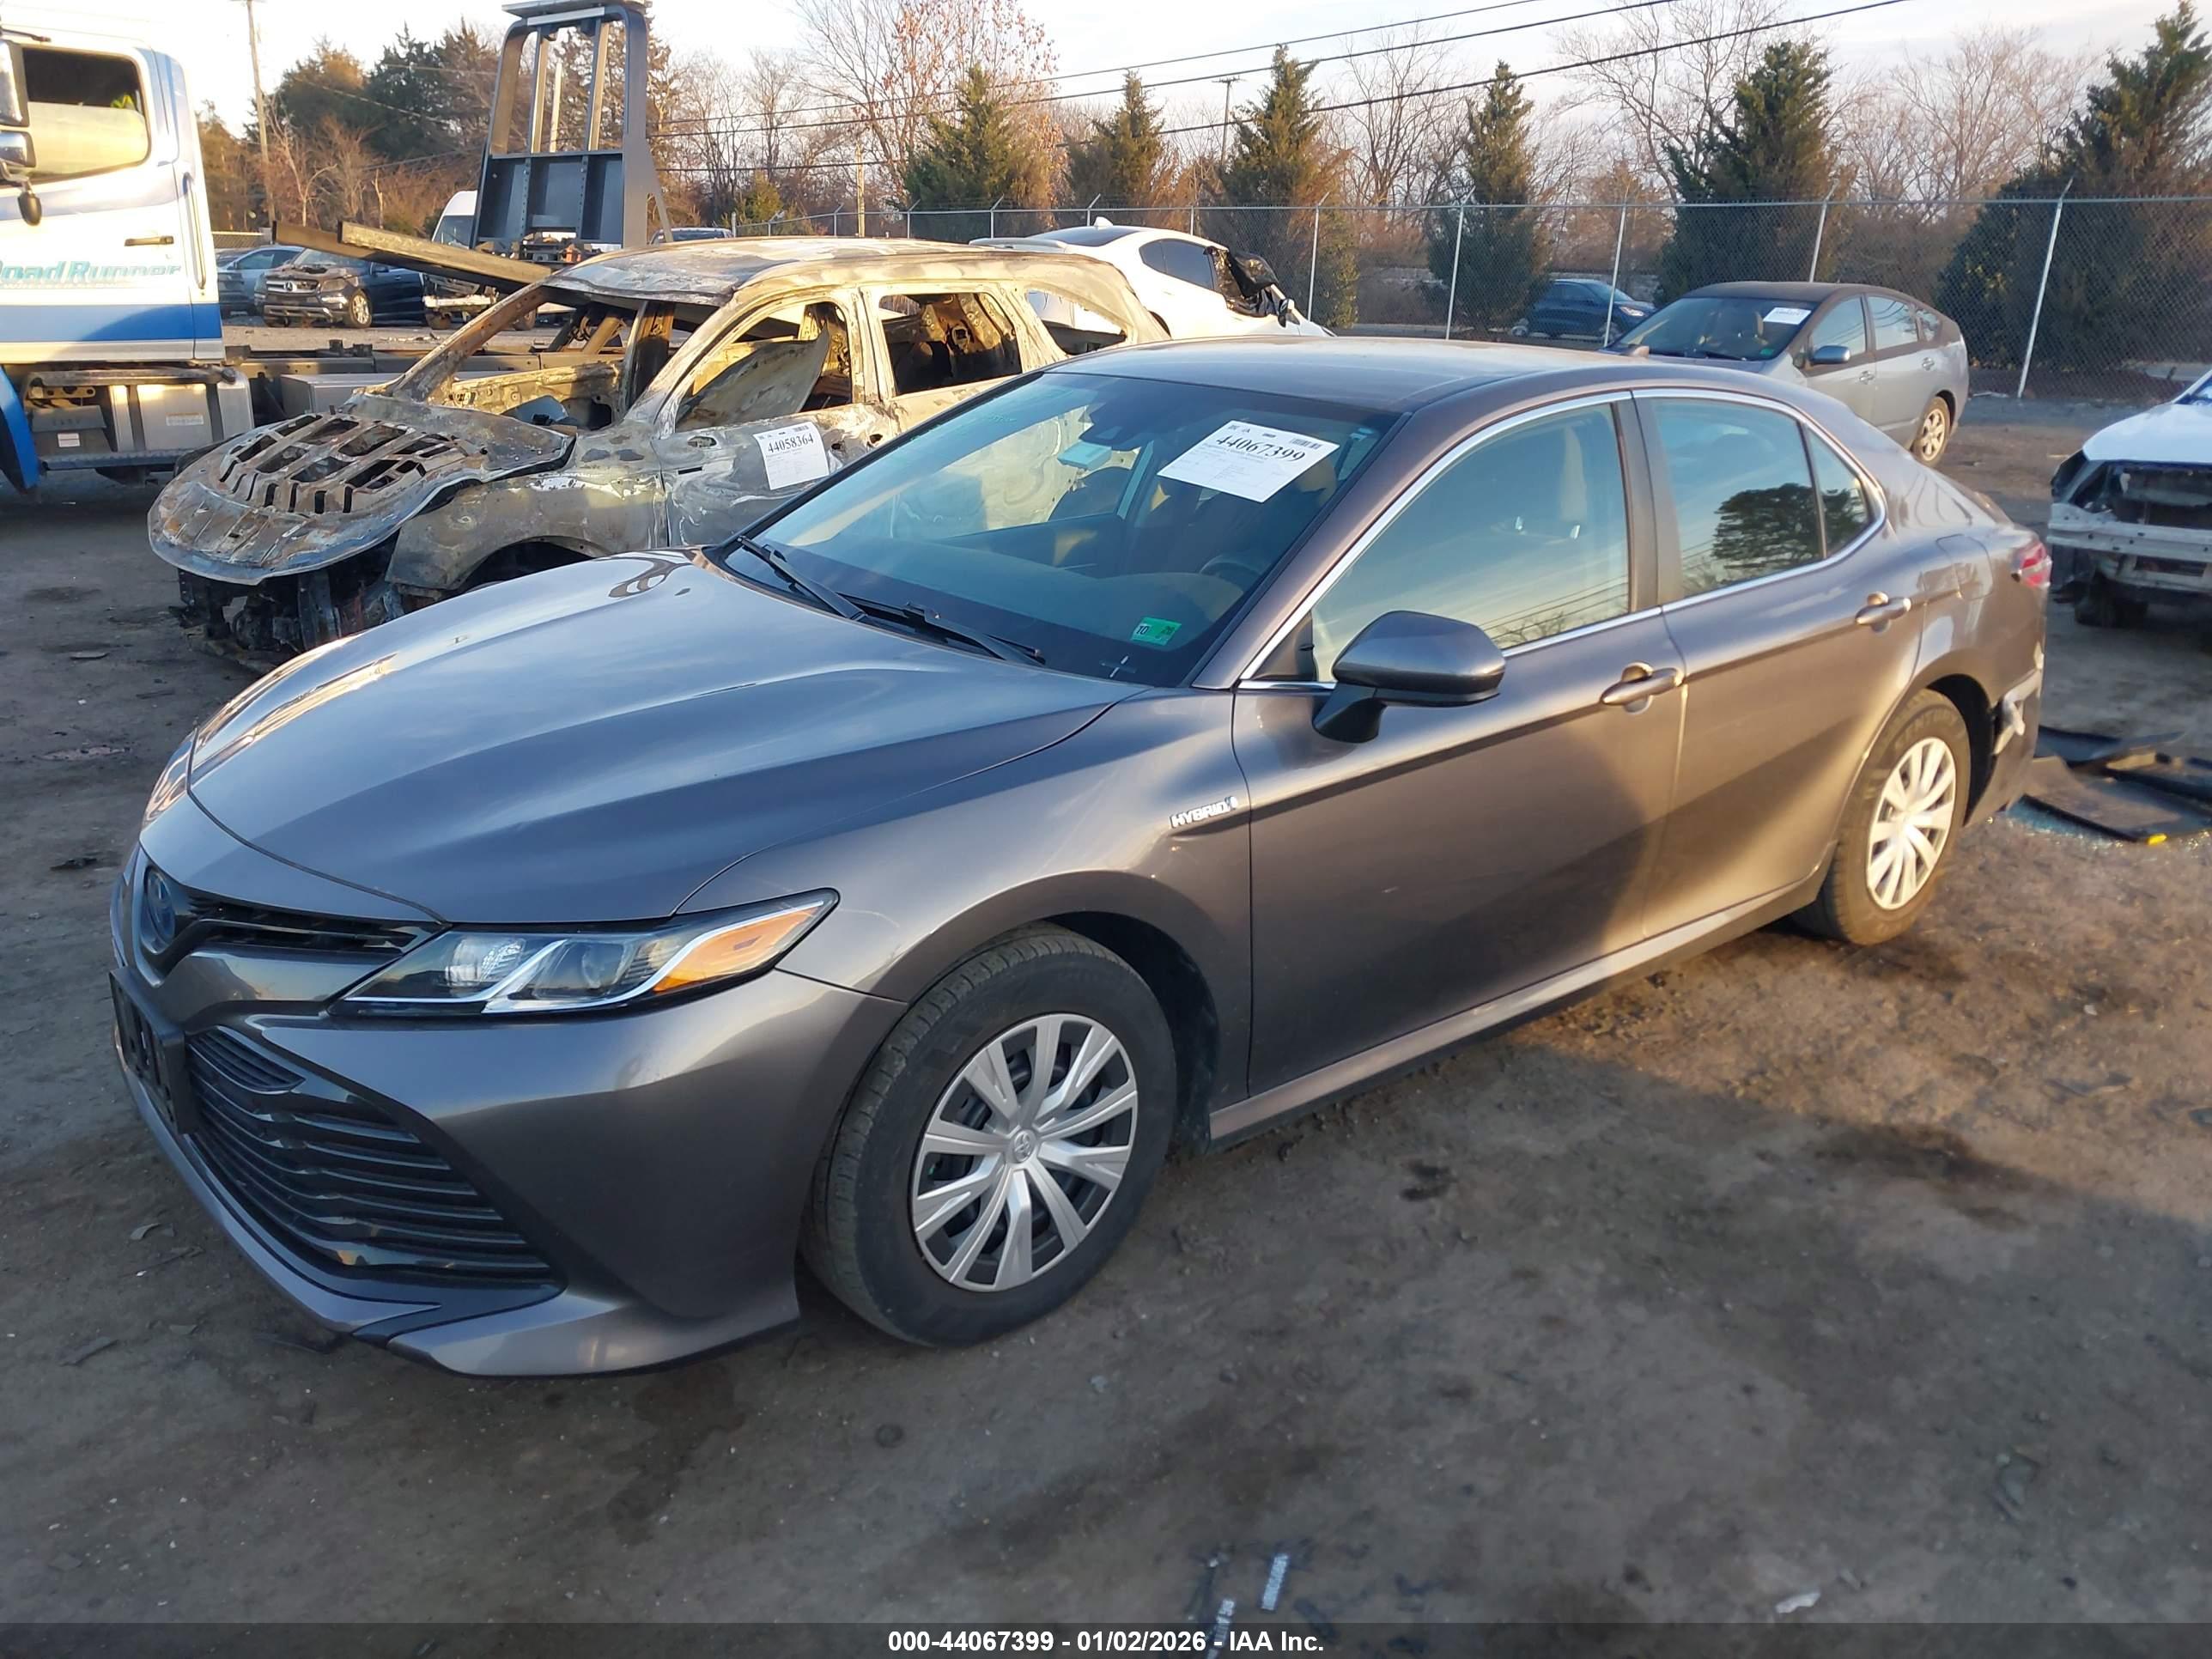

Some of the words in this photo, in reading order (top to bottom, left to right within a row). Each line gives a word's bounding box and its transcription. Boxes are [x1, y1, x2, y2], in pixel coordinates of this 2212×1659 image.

[0, 260, 66, 282] oad
[768, 433, 814, 453] 44058364
[1216, 435, 1305, 461] 44067399
[1170, 801, 1231, 828] HYBRID
